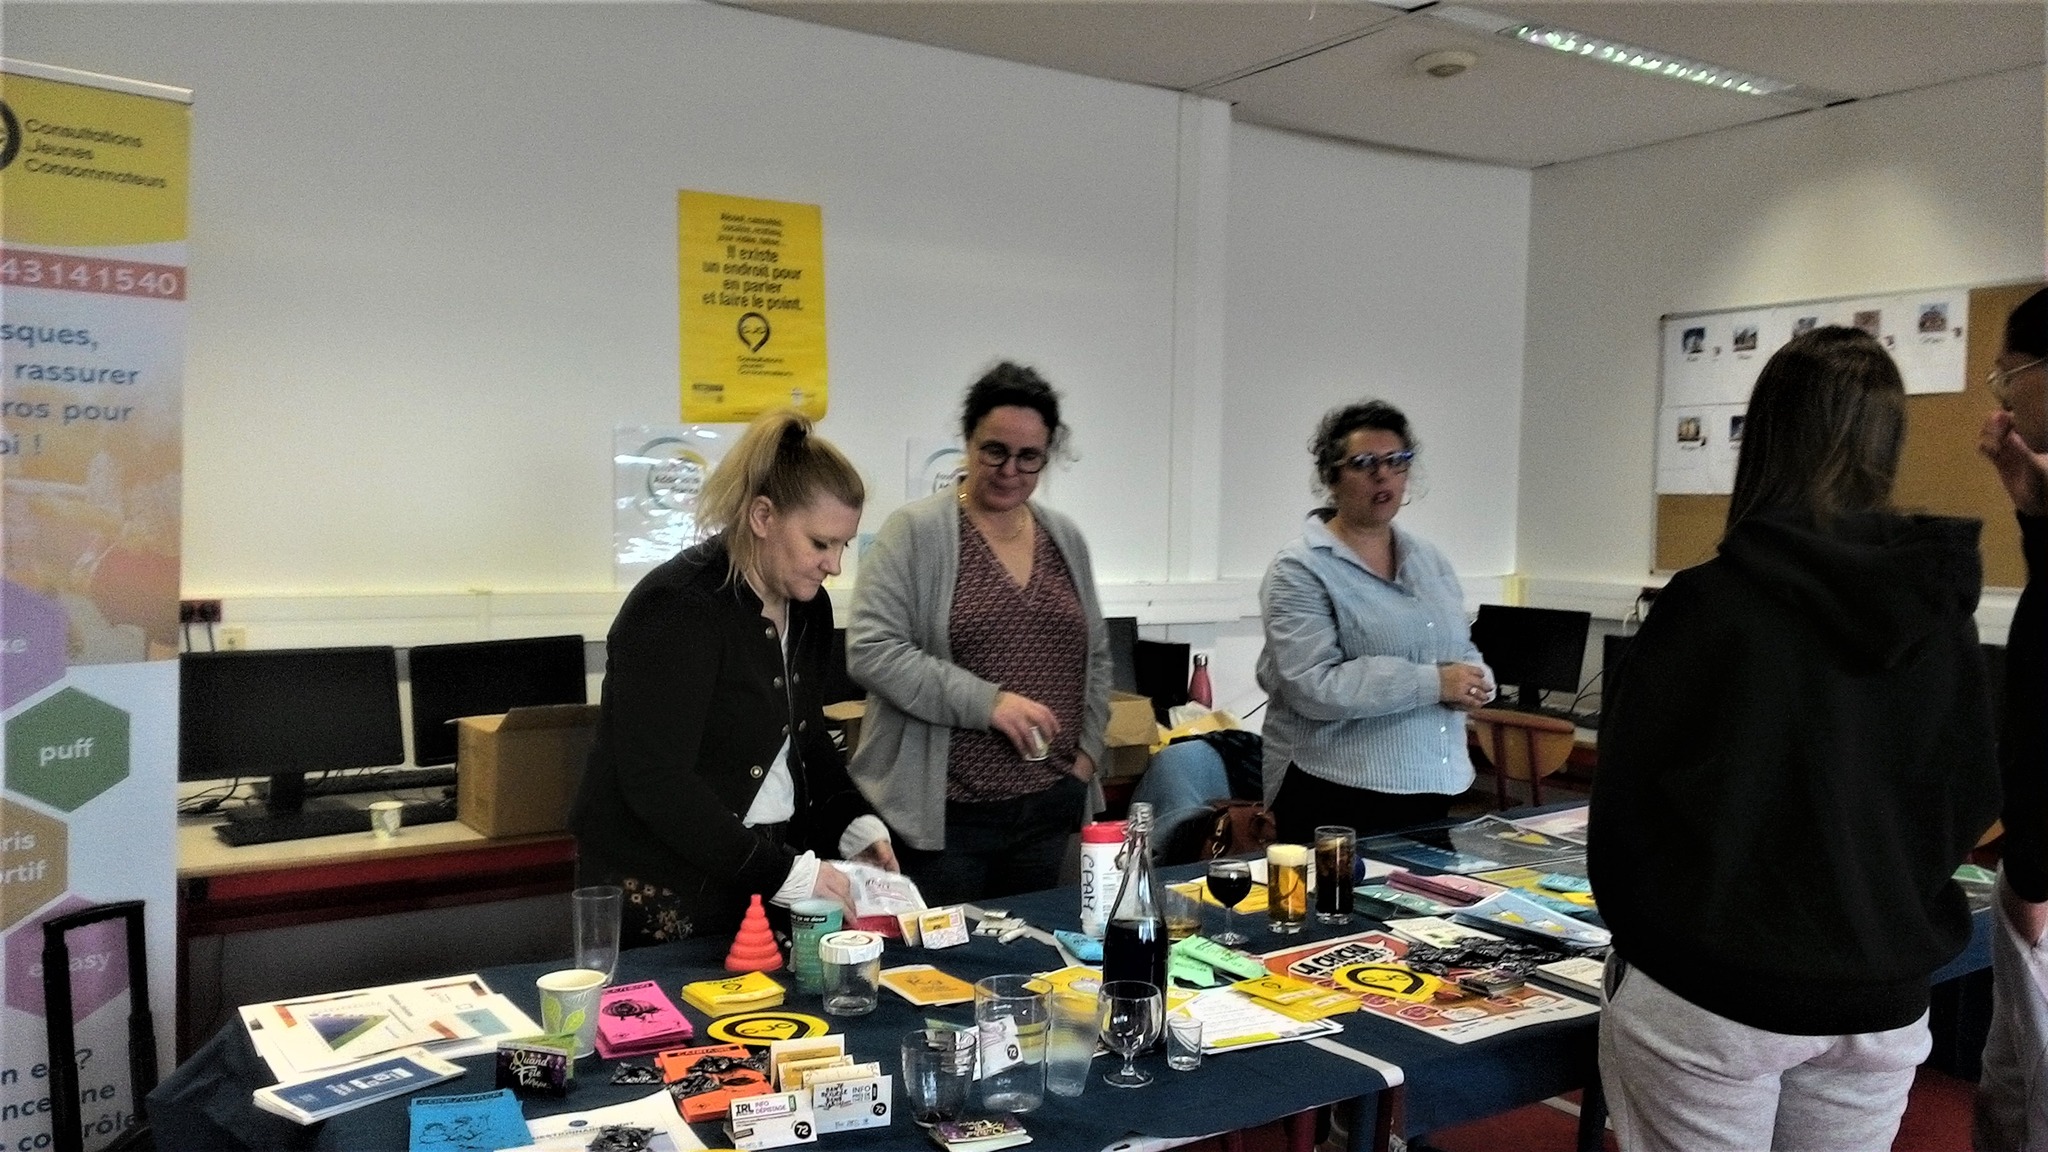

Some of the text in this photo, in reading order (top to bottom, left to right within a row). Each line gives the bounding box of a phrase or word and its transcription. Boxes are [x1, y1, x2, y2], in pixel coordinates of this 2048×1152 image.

[25, 118, 143, 148] Consultations
[25, 139, 95, 160] Jeunes
[24, 158, 168, 189] Consommateurs
[740, 248, 778, 263] existe
[702, 261, 802, 281] un endroit pour
[723, 279, 782, 294] en parler
[702, 291, 717, 305] et
[719, 292, 748, 308] faire
[751, 294, 764, 309] le
[15, 364, 139, 385] rassurer
[63, 404, 134, 427] pour
[40, 737, 97, 767] puff
[0, 859, 48, 884] rtif
[741, 1022, 793, 1034] CJC
[852, 1085, 871, 1093] INFO
[735, 1103, 754, 1114] IRL
[874, 1105, 885, 1114] 72
[18, 1109, 138, 1152] corôle
[796, 1124, 809, 1136] 72
